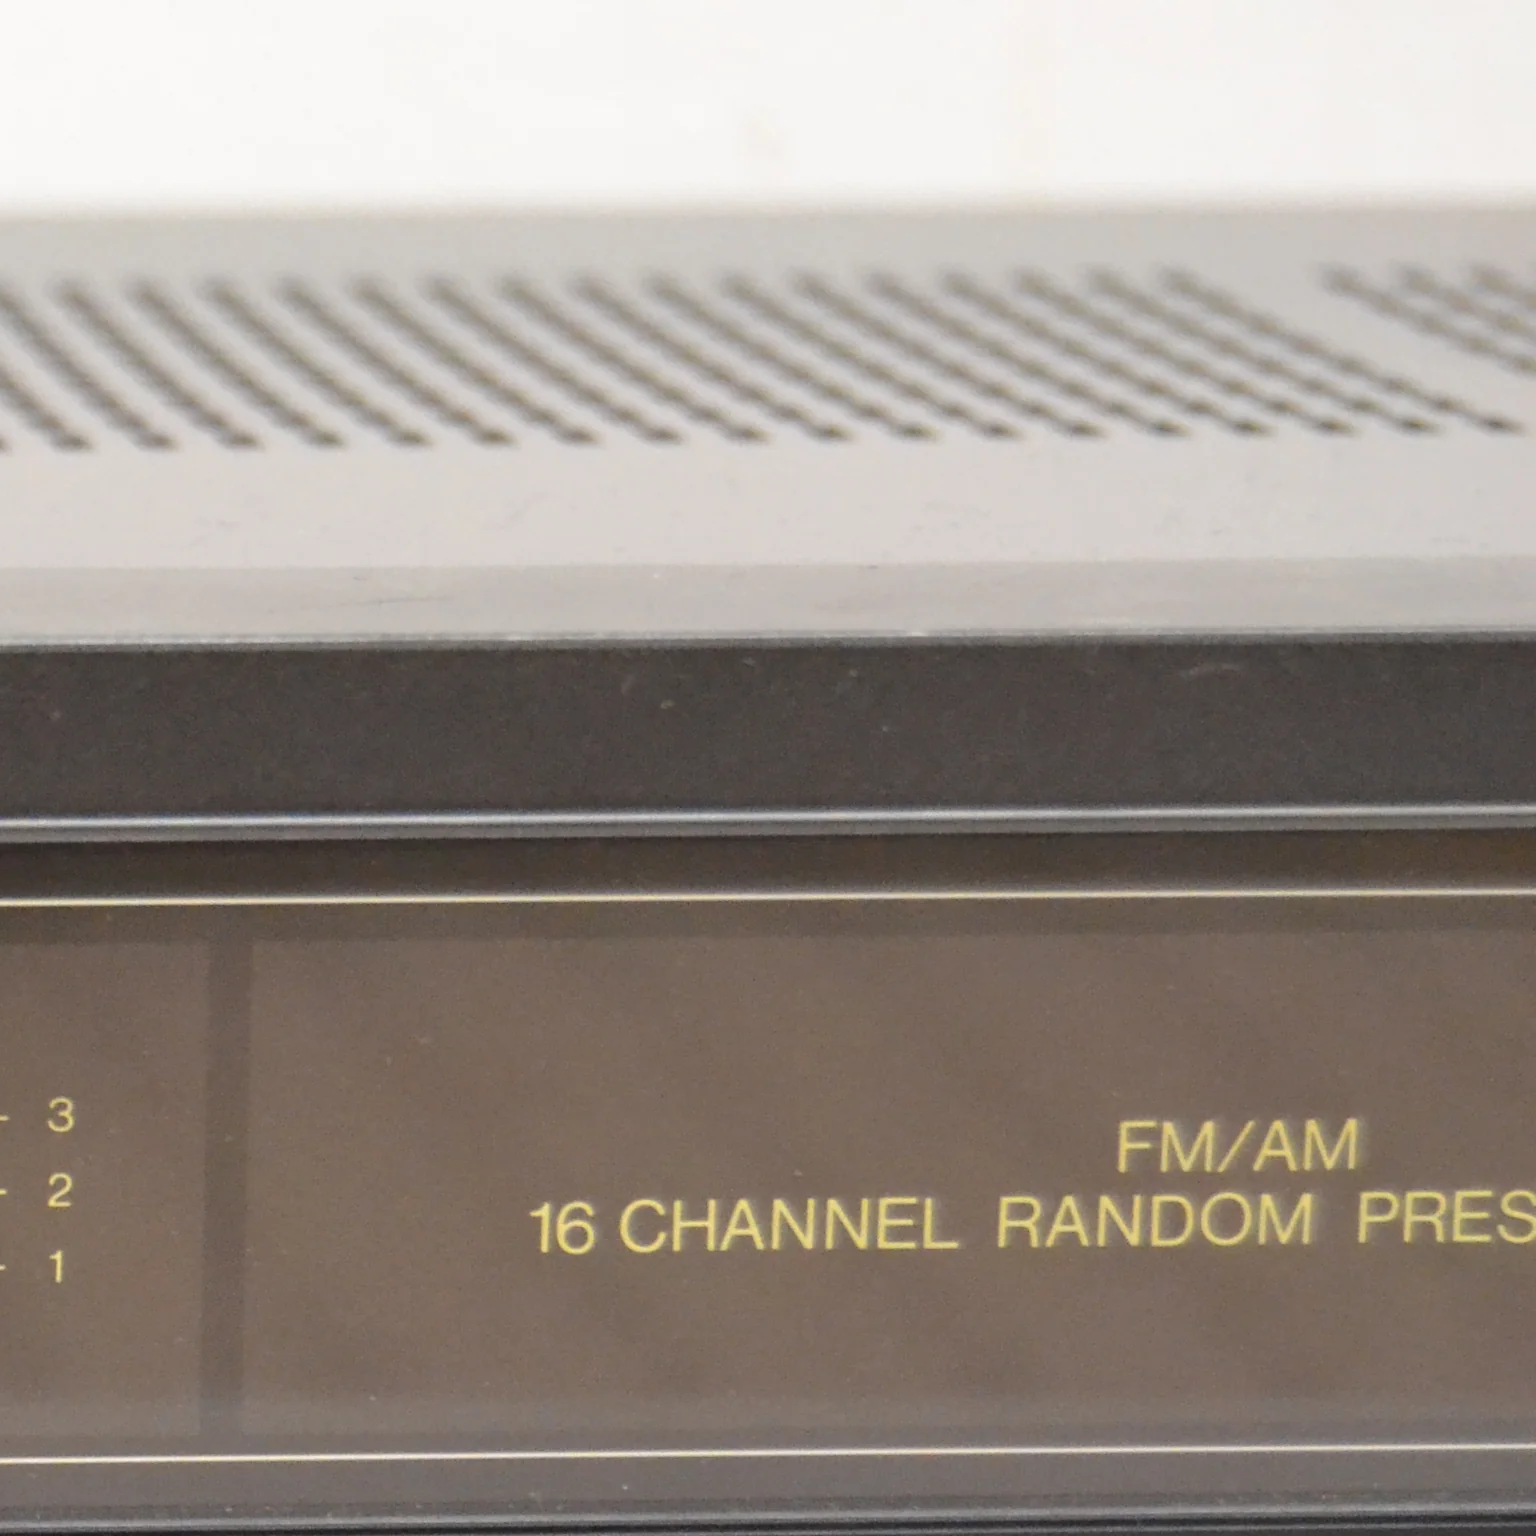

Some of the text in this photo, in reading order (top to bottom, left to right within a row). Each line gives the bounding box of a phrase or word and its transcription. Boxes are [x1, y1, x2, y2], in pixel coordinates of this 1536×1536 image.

[47, 1096, 75, 1133] 3
[1118, 1117, 1358, 1173] FM/AM
[47, 1172, 73, 1208] 2
[529, 1189, 1536, 1255] 16 CHANNEL RANDOM PRES
[50, 1250, 63, 1283] 1
